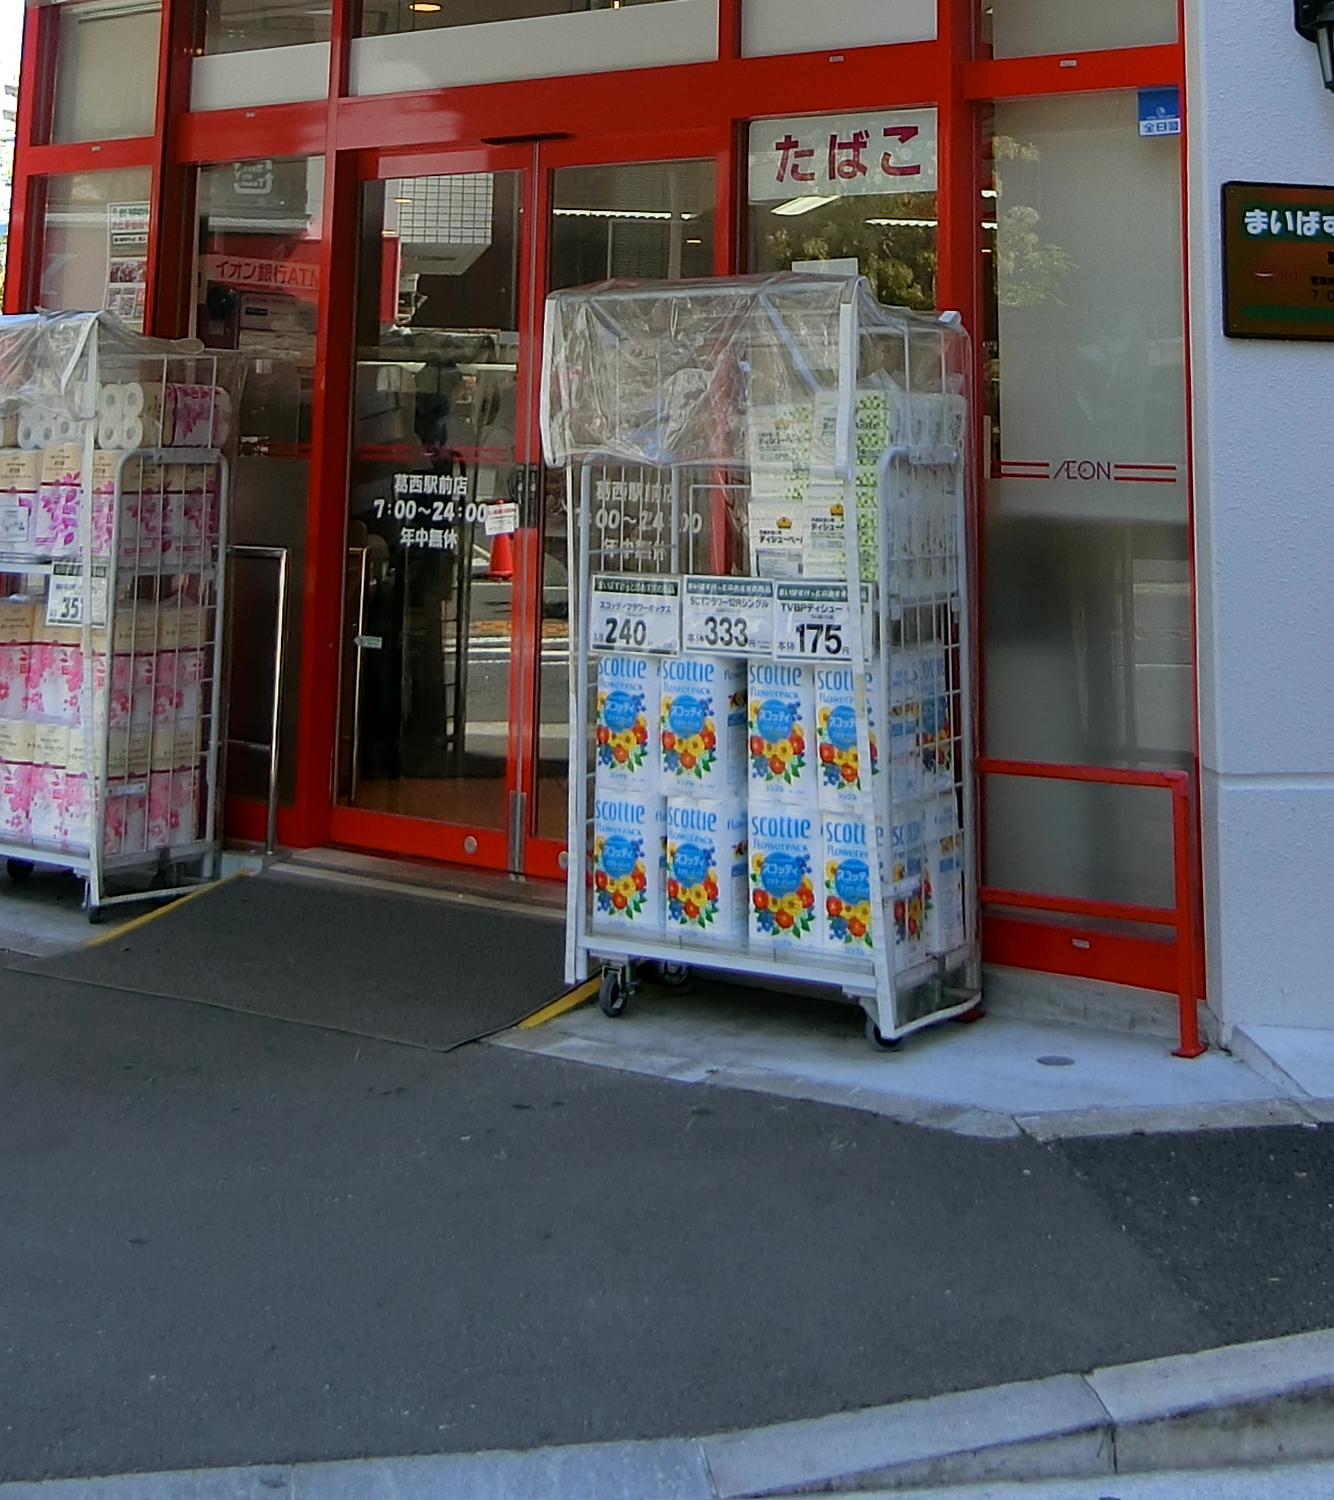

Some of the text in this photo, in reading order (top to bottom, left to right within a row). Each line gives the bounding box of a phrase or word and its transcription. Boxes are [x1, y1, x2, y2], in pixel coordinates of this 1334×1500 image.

[774, 125, 921, 183] たばこ
[394, 473, 468, 496] 葛西駅前店
[399, 526, 459, 549] 年中無休
[61, 596, 84, 619] 35
[605, 617, 647, 647] 240
[704, 615, 749, 648] 333
[795, 623, 842, 655] 175
[599, 656, 647, 679] scottie
[662, 659, 714, 683] scottie
[749, 664, 803, 687] scottie
[818, 669, 873, 692] scotte
[670, 705, 703, 717] スコッティ
[759, 709, 790, 721] スコッティ
[829, 715, 857, 729] スコッテ
[595, 800, 646, 824] scottie
[668, 806, 717, 832] scottie
[751, 816, 811, 839] scottie
[825, 821, 884, 847] scotte
[674, 852, 706, 866] スコッティ
[763, 862, 799, 875] スコッティ
